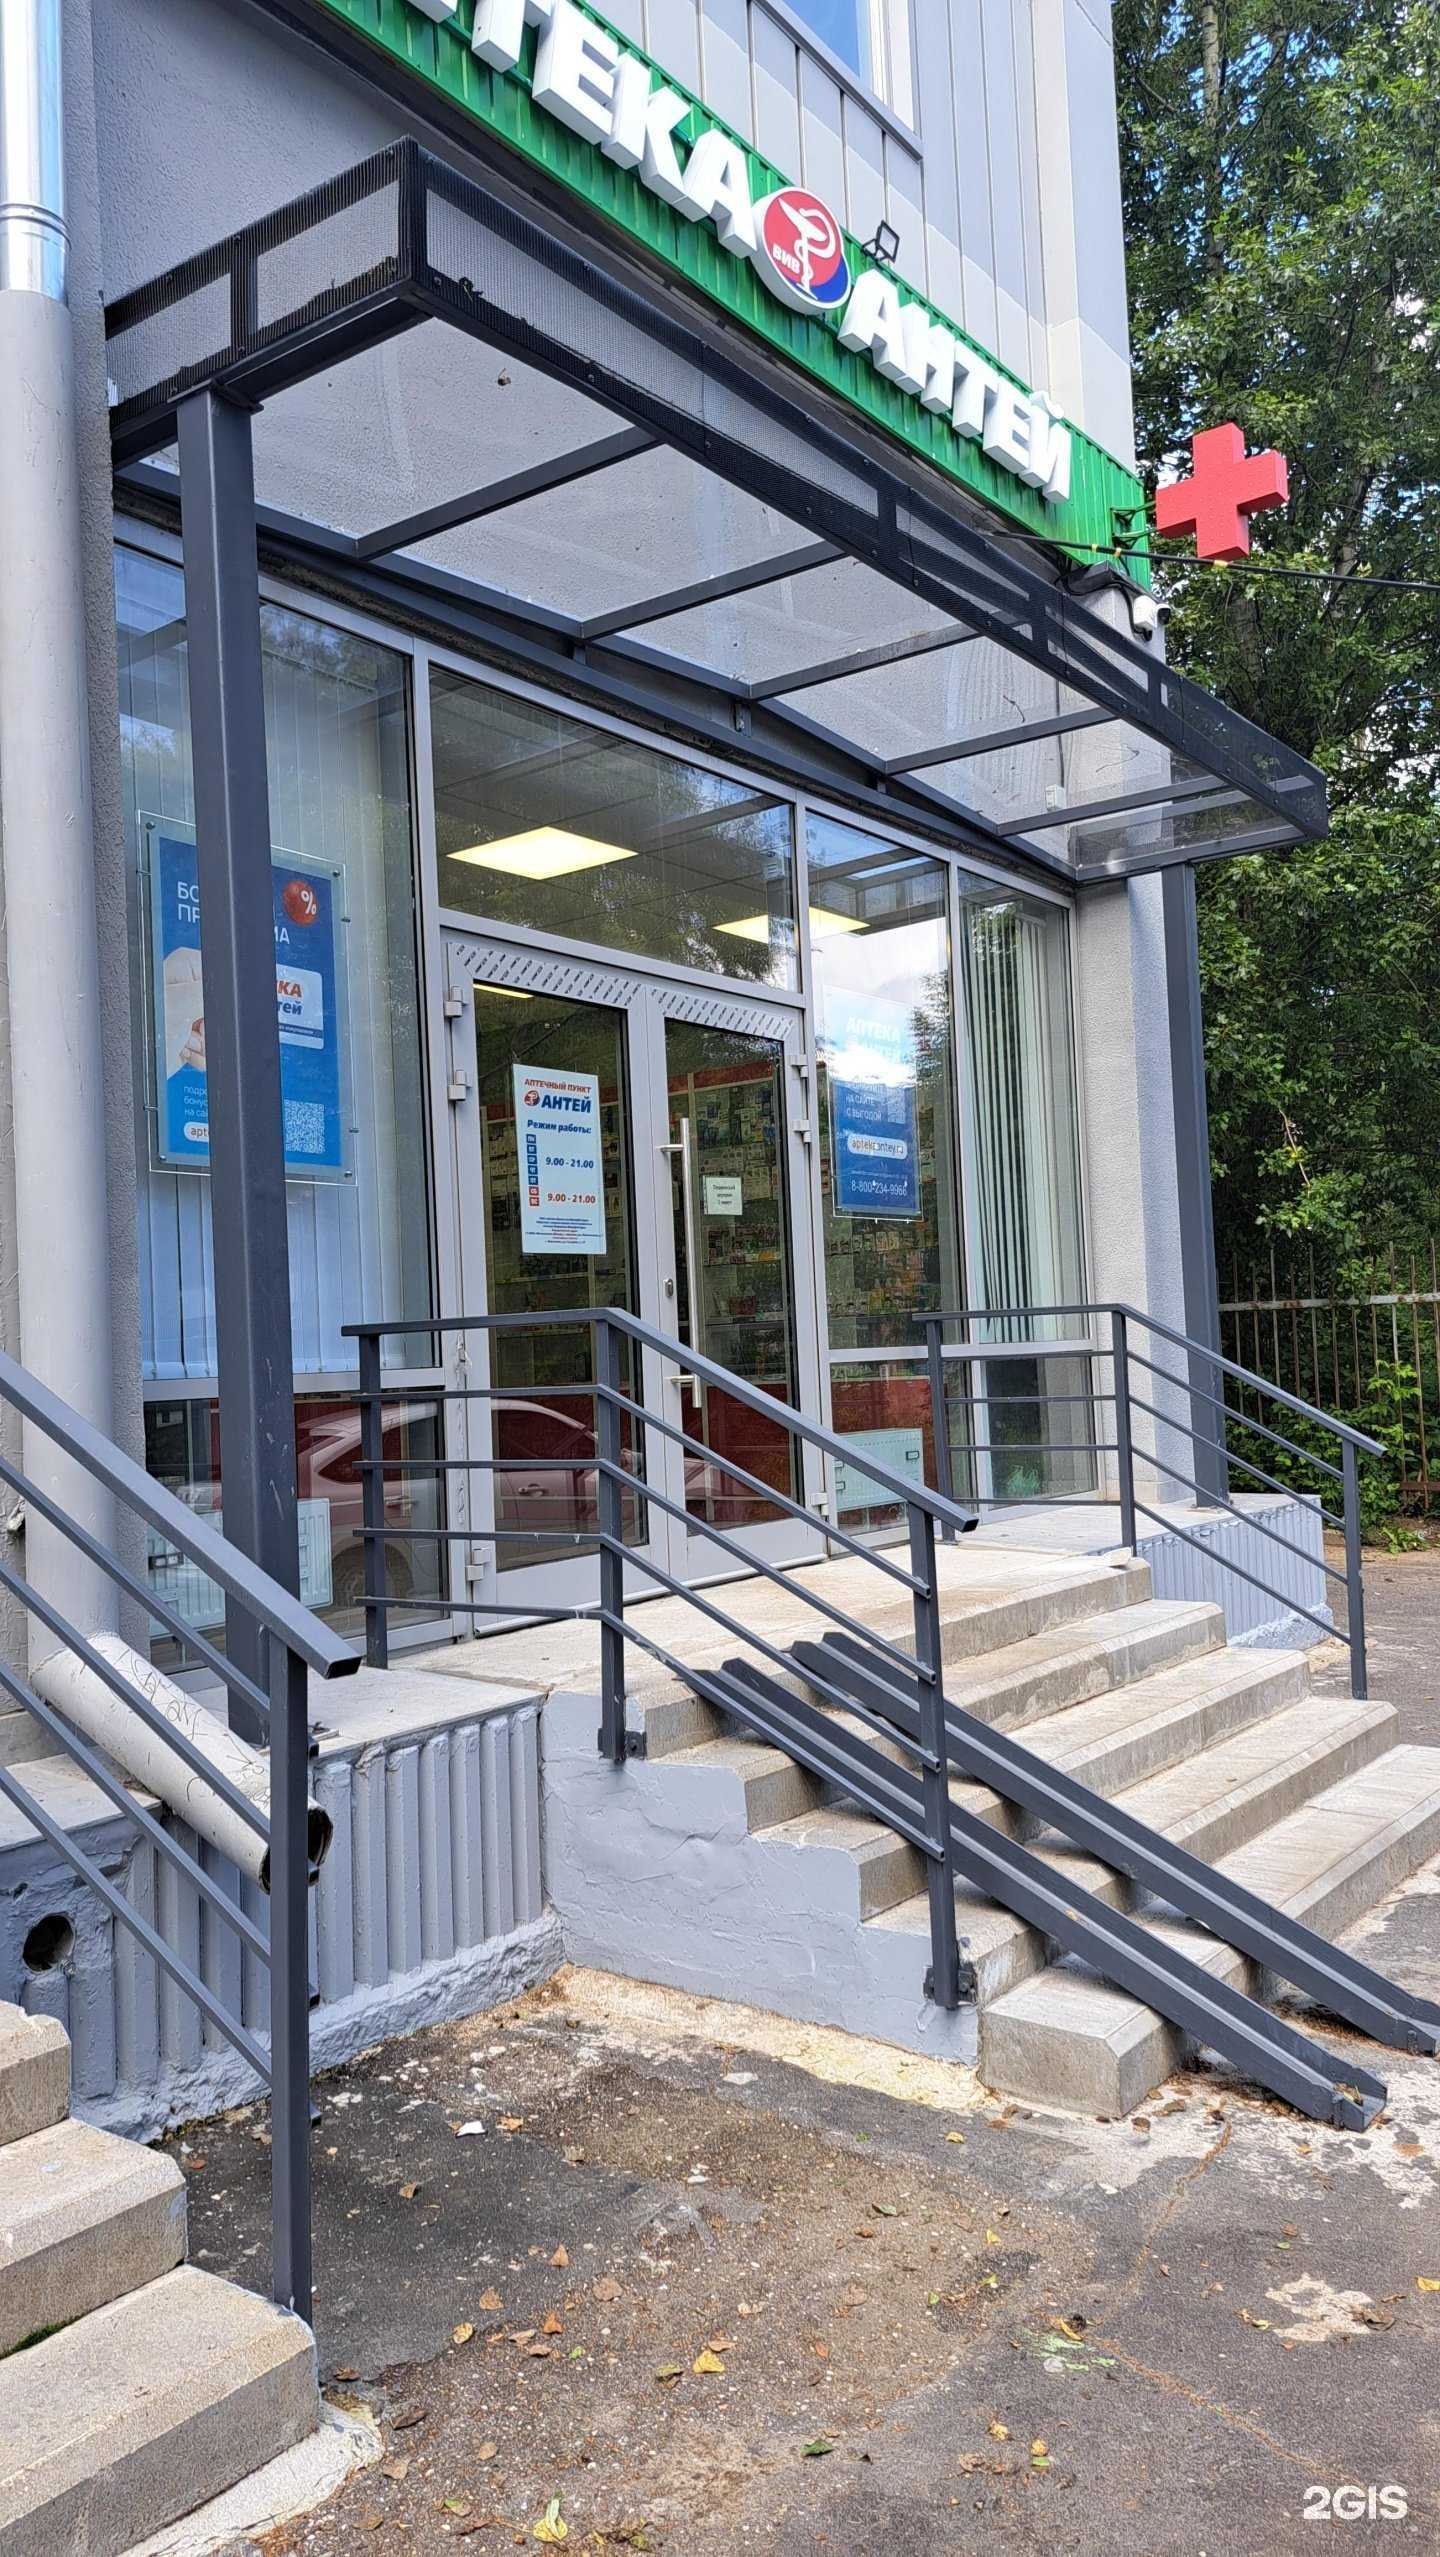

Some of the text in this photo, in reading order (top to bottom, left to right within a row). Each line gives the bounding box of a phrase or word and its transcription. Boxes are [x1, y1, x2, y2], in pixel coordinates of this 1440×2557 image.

[404, 0, 1072, 504] ТЕКА АНТЕЙ
[772, 243, 801, 275] ВИВ
[524, 1078, 592, 1094] АПТЕЧНЫЙ ПУНКТ
[541, 1095, 591, 1113] АНТЕЙ
[527, 1119, 592, 1135] Режим работы:
[545, 1156, 565, 1167] 9.00
[570, 1159, 594, 1169] 21.00
[547, 1192, 567, 1203] 9.00
[572, 1195, 596, 1204] 21.00
